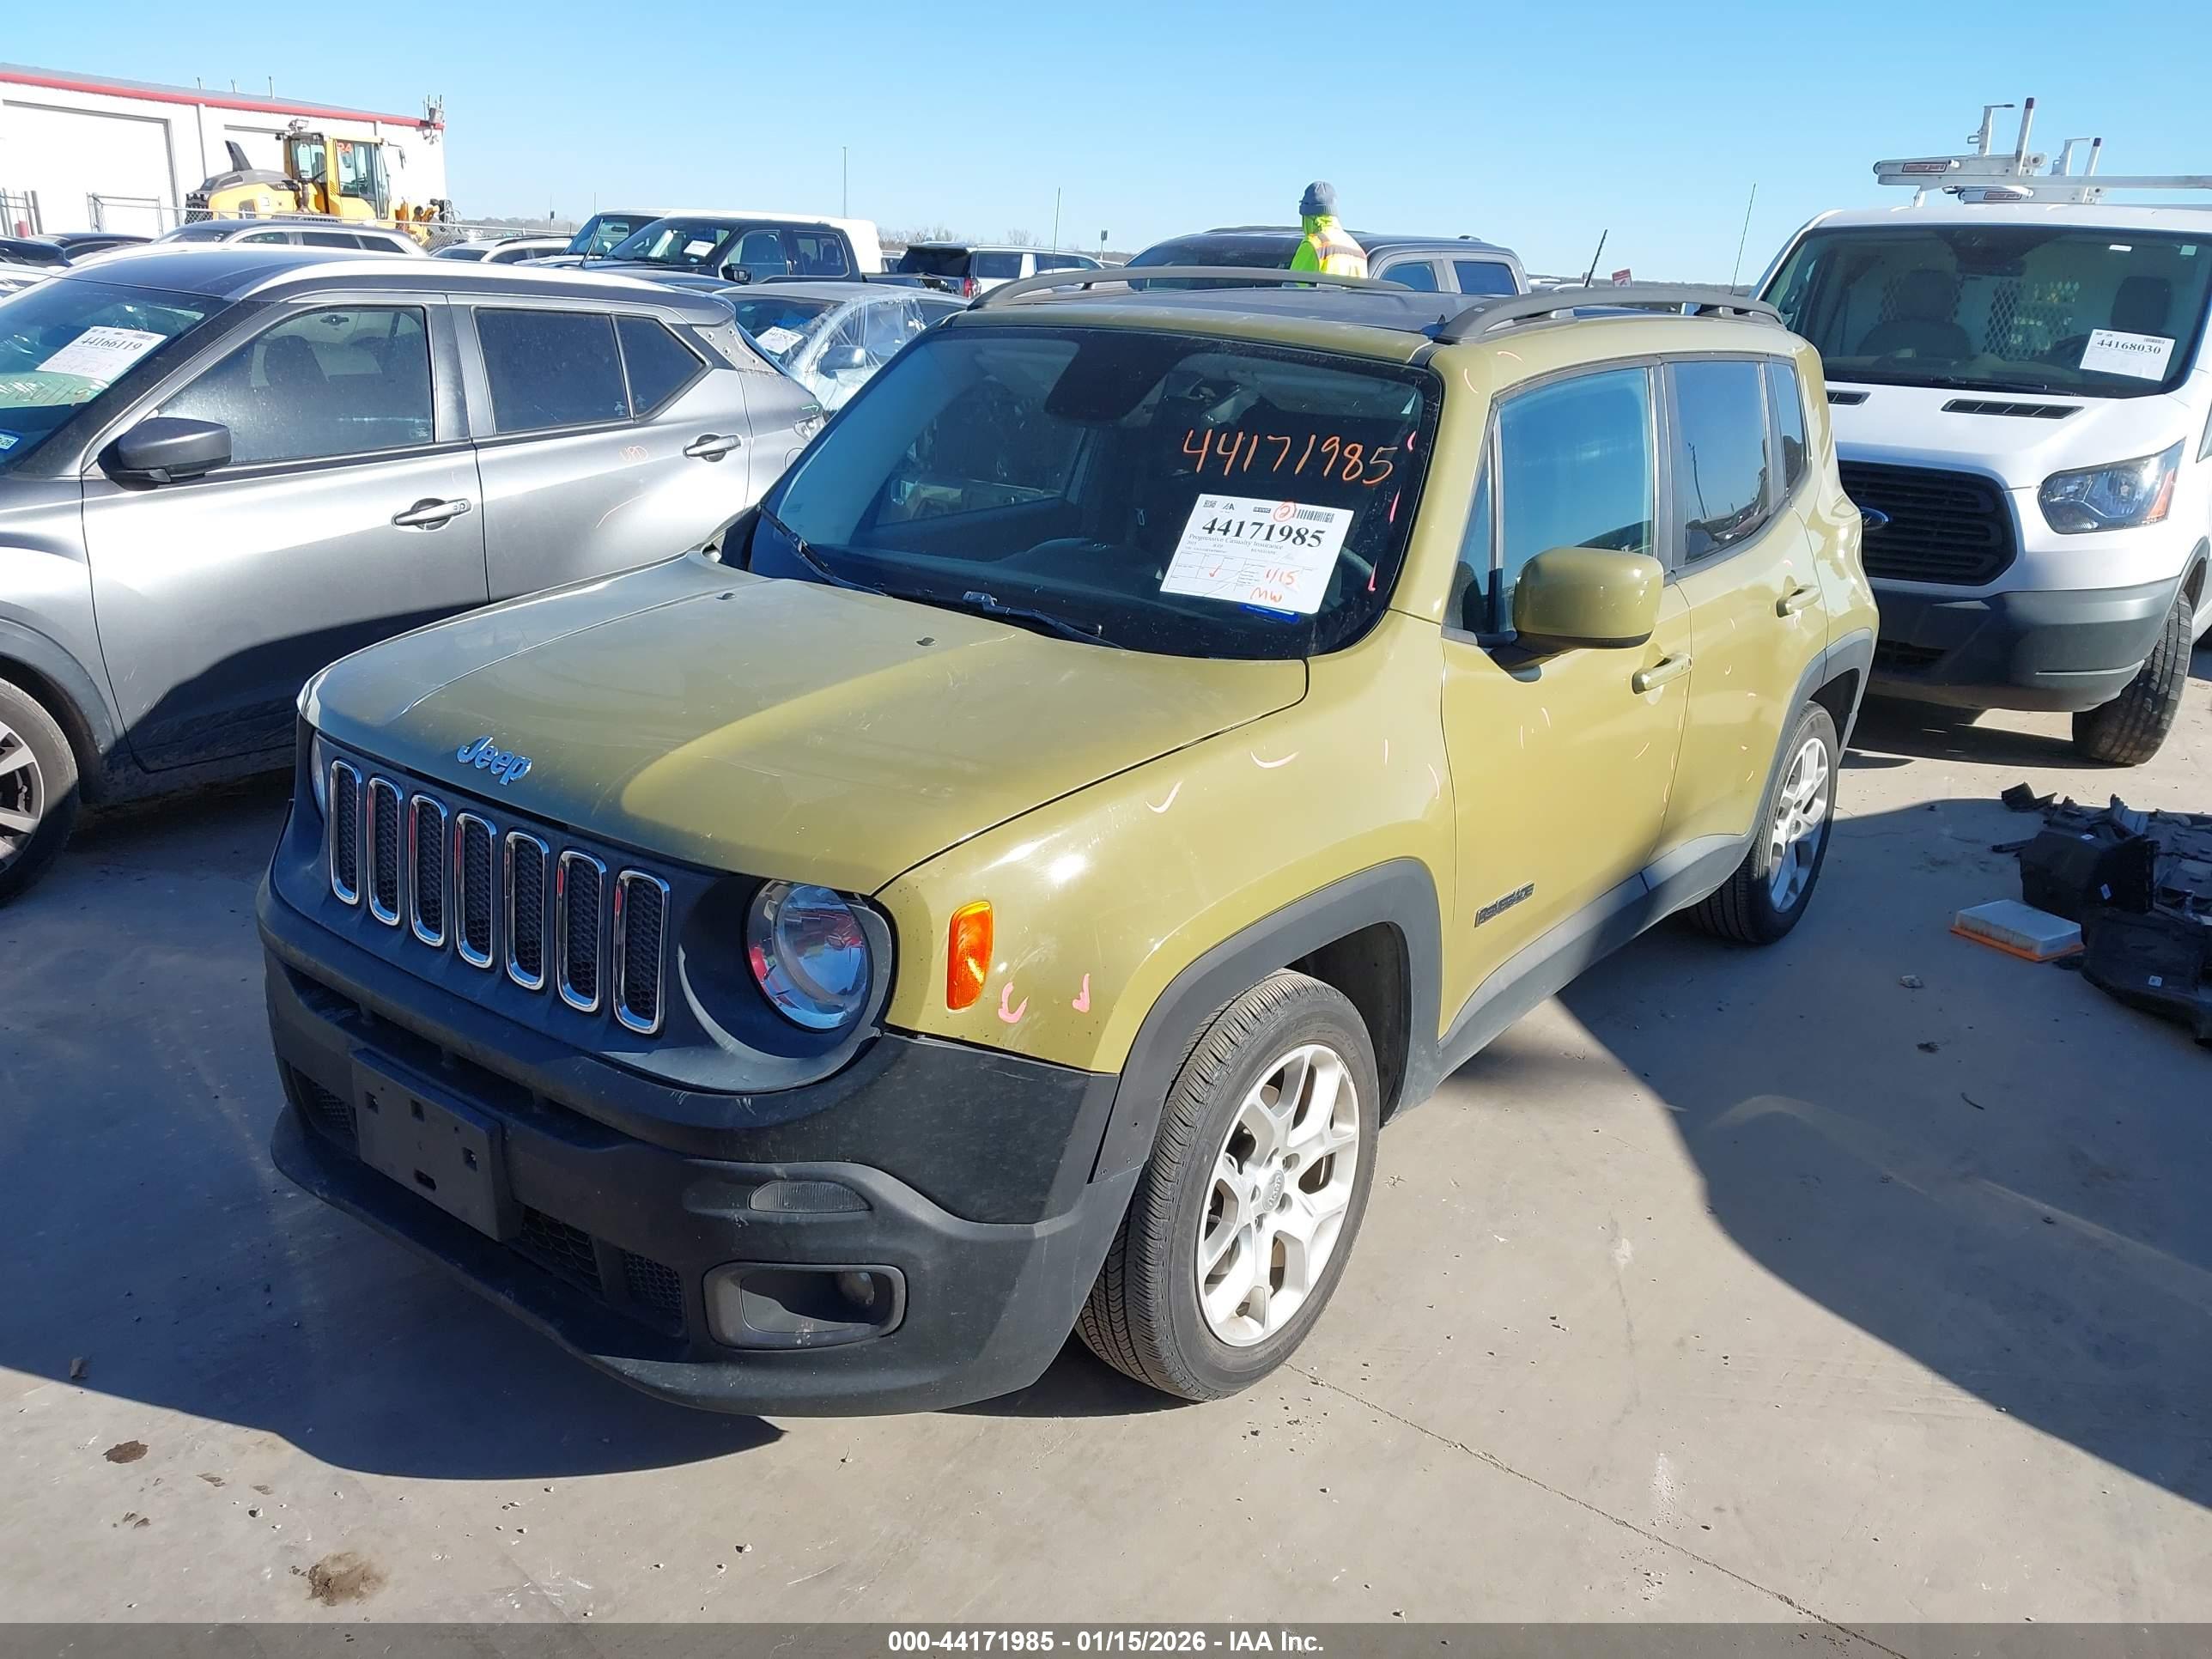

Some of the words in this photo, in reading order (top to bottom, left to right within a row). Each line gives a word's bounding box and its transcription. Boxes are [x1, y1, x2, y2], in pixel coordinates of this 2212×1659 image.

[82, 336, 143, 351] 44166119
[2097, 338, 2161, 355] 44168030
[1182, 428, 1398, 484] 44171985
[1188, 533, 1224, 543] Progressive
[1225, 538, 1253, 548] Casualty
[1253, 541, 1284, 550] Insurance
[1202, 517, 1326, 548] 44171985
[1265, 567, 1300, 586] 1/15
[1250, 586, 1283, 603] MW
[457, 735, 532, 786] Jeep
